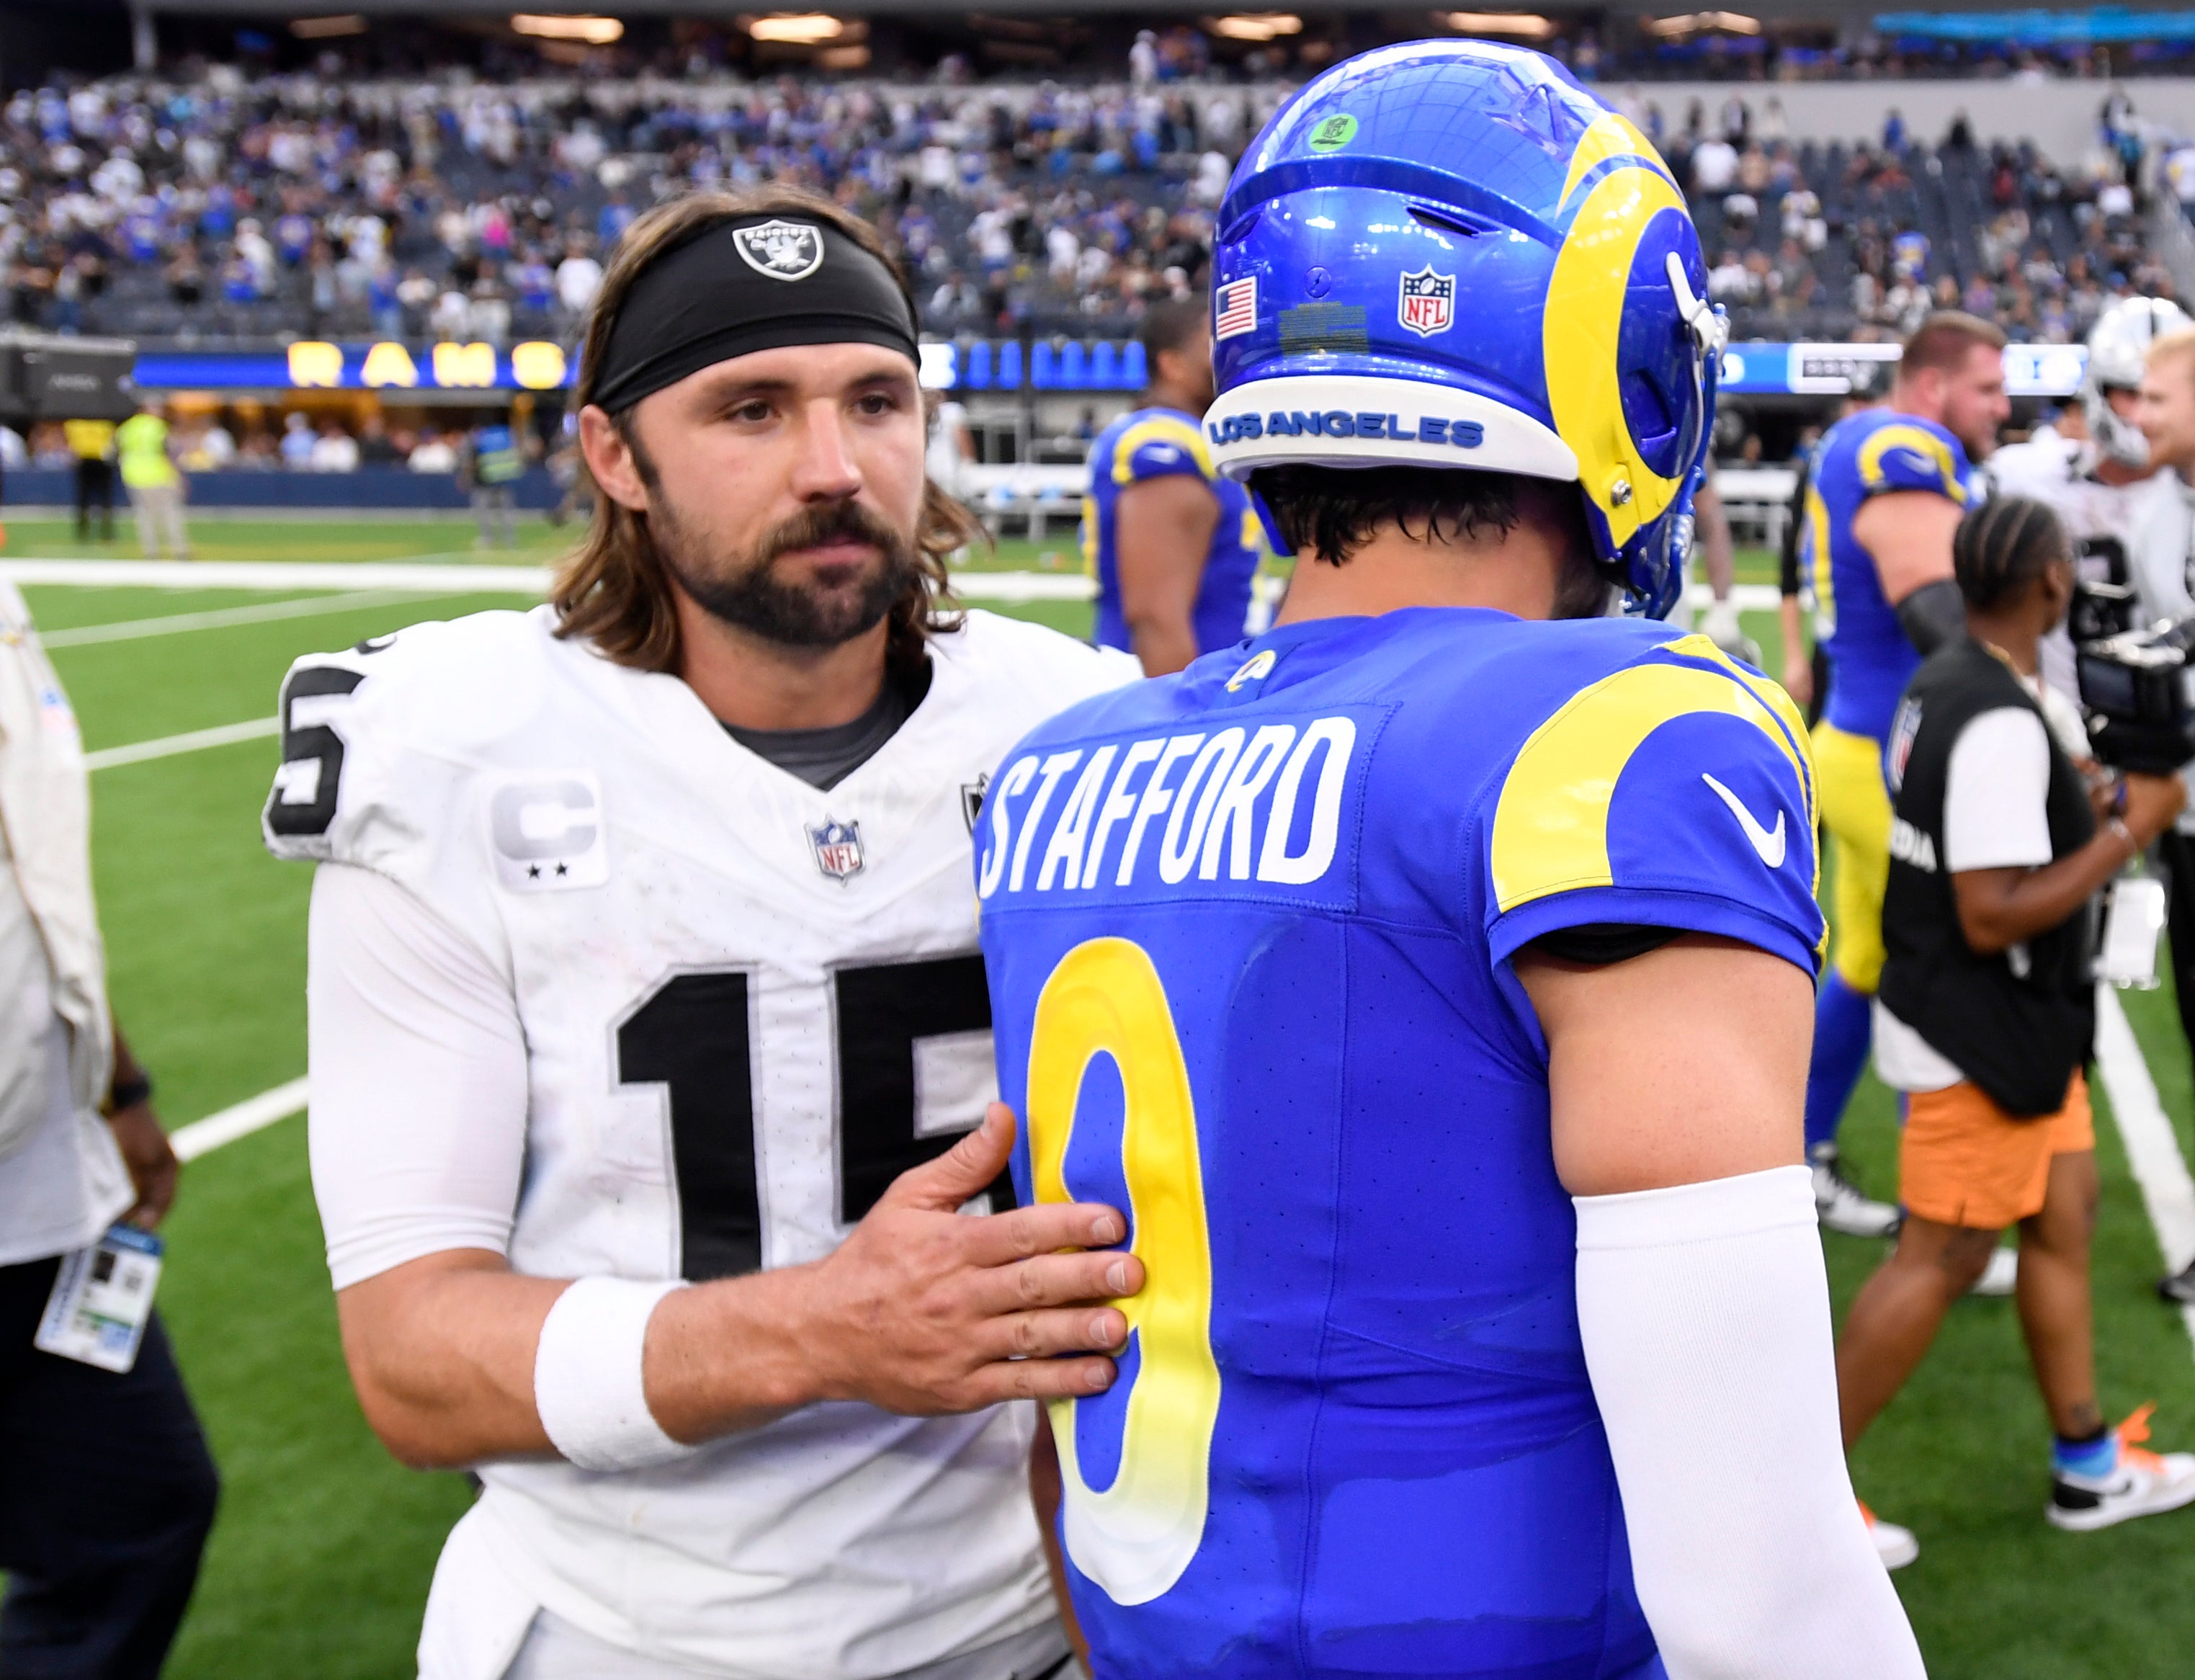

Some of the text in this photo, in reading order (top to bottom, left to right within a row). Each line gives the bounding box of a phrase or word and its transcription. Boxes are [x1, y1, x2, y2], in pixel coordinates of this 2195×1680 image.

[1406, 298, 1446, 326] NFL
[287, 341, 567, 389] RAMS
[1208, 409, 1485, 448] LOS ANGELES
[269, 666, 367, 836] 5
[491, 779, 598, 861] C
[980, 715, 1356, 899] STAFFORD
[821, 846, 859, 873] NFL
